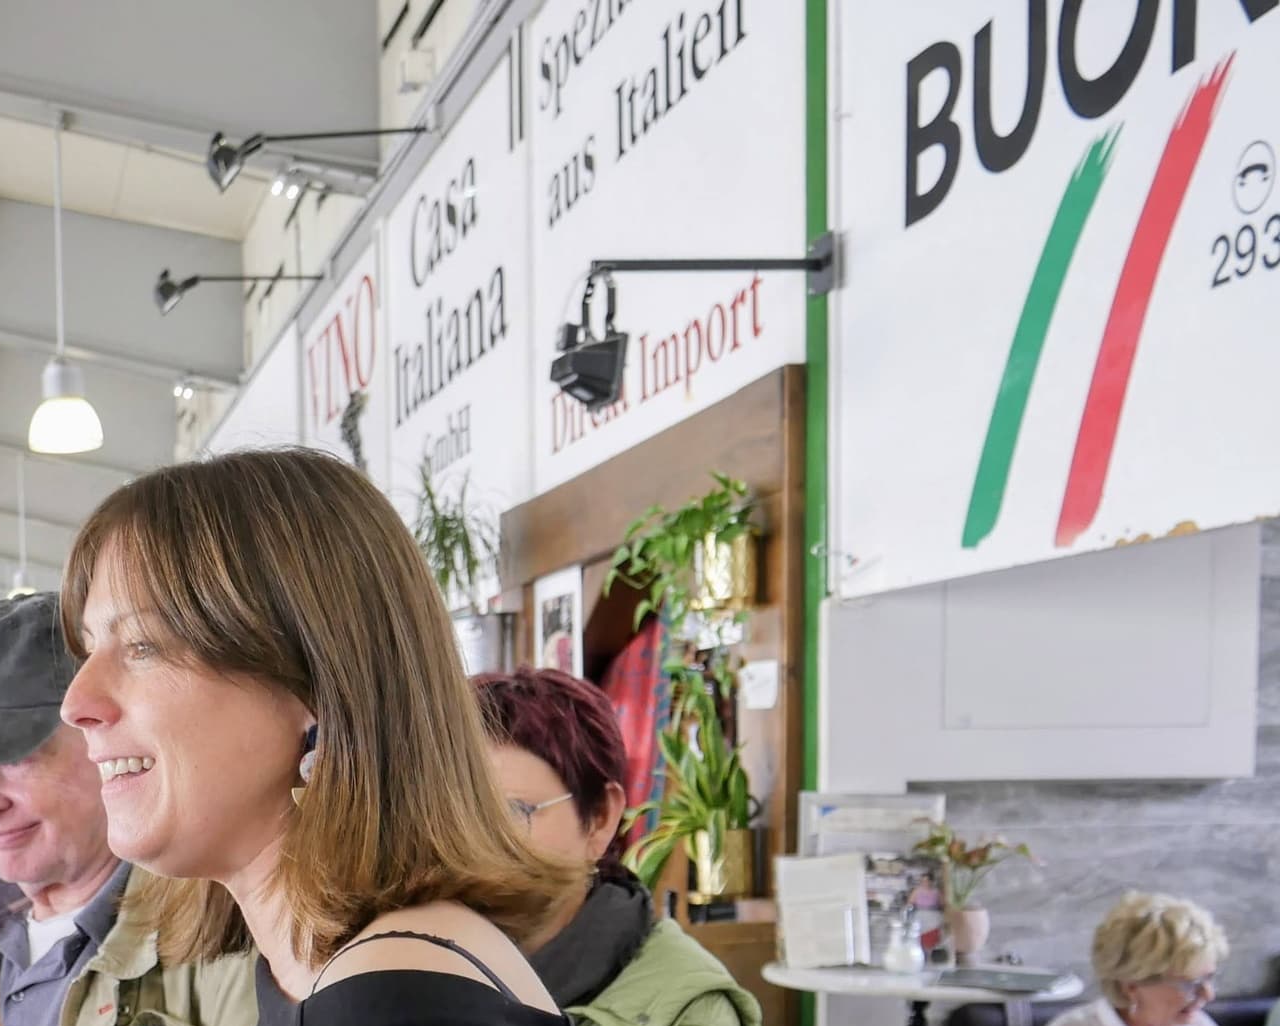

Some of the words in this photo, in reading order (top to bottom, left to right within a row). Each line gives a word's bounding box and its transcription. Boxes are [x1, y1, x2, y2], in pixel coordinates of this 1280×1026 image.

[539, 0, 633, 119] Spez
[548, 133, 596, 229] aus
[614, 0, 747, 163] Italien
[410, 157, 478, 288] Casa
[393, 265, 509, 429] Italiana
[638, 270, 765, 404] Import
